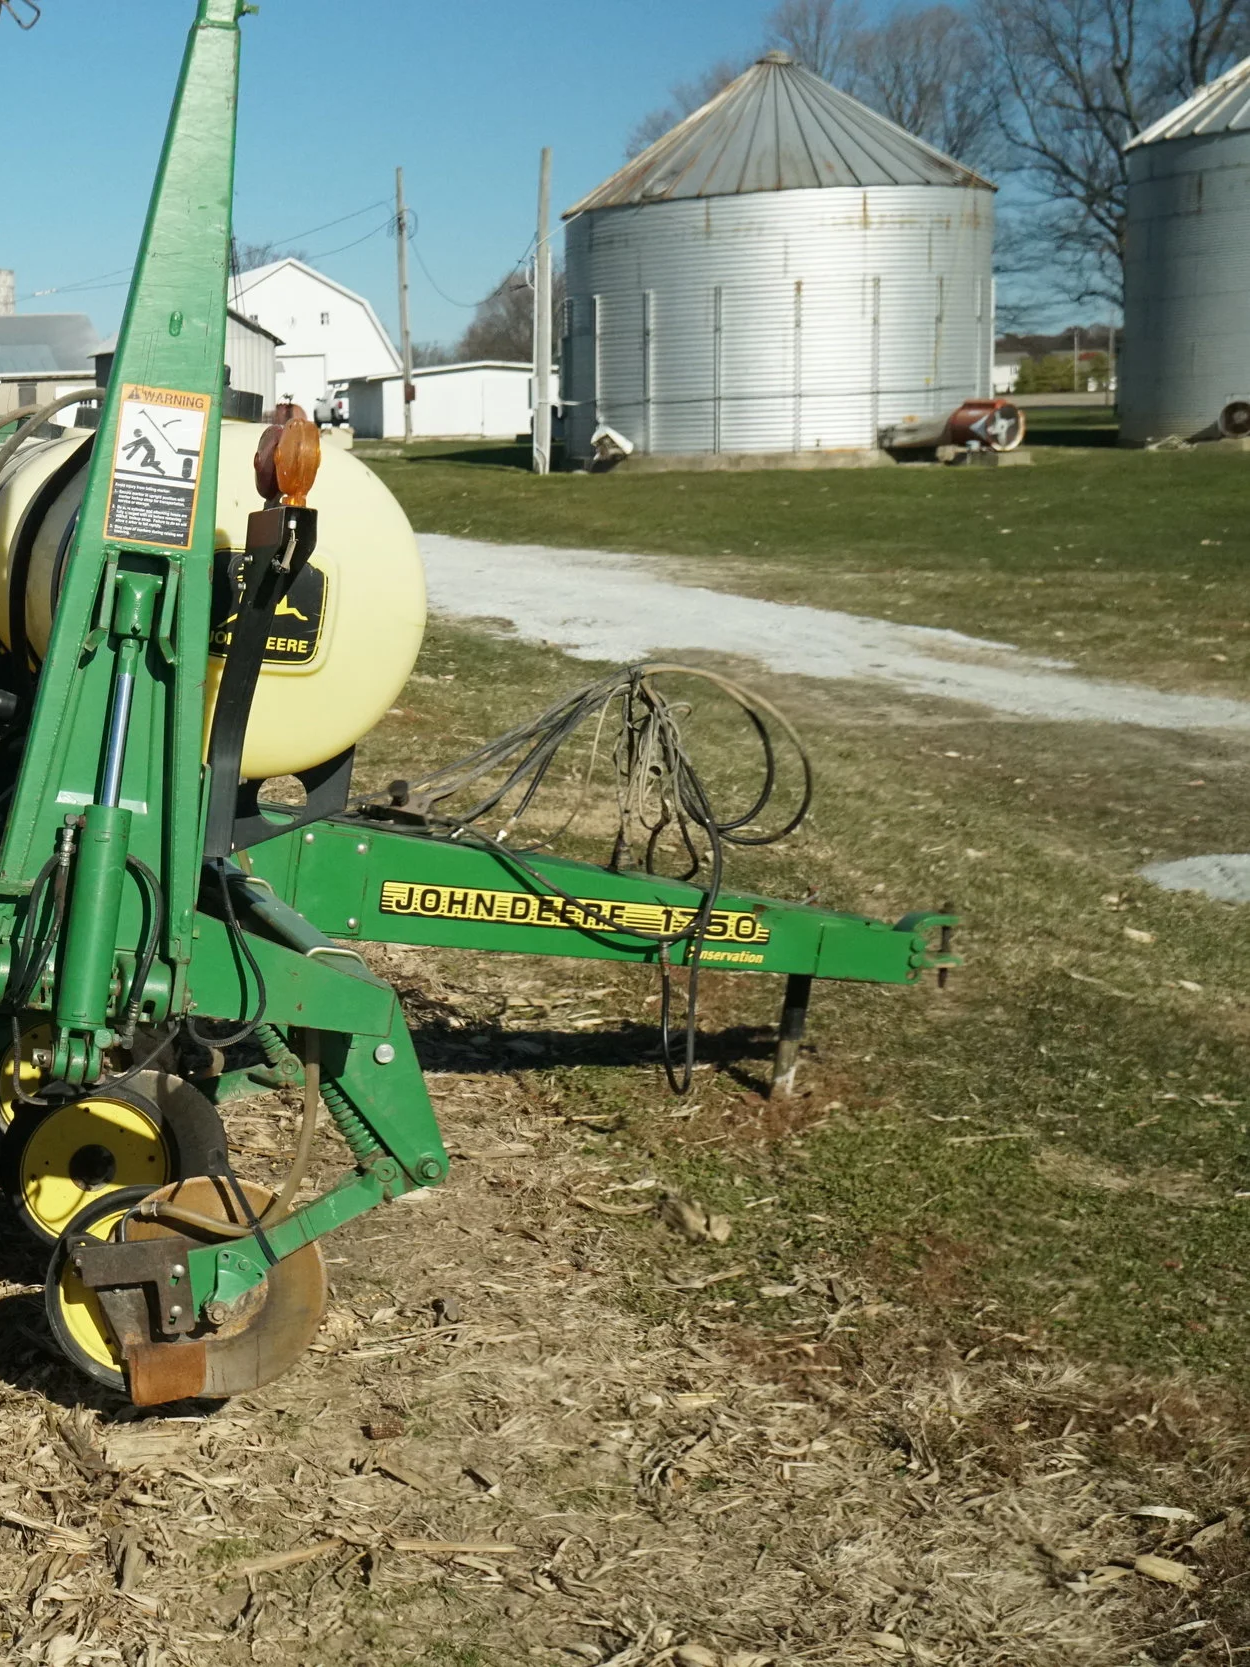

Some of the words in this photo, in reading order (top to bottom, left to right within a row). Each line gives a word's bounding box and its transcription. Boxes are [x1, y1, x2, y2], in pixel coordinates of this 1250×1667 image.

[144, 390, 204, 409] WARNING
[266, 637, 308, 653] EERE
[395, 887, 496, 917] JOHN
[689, 946, 764, 963] nservation
